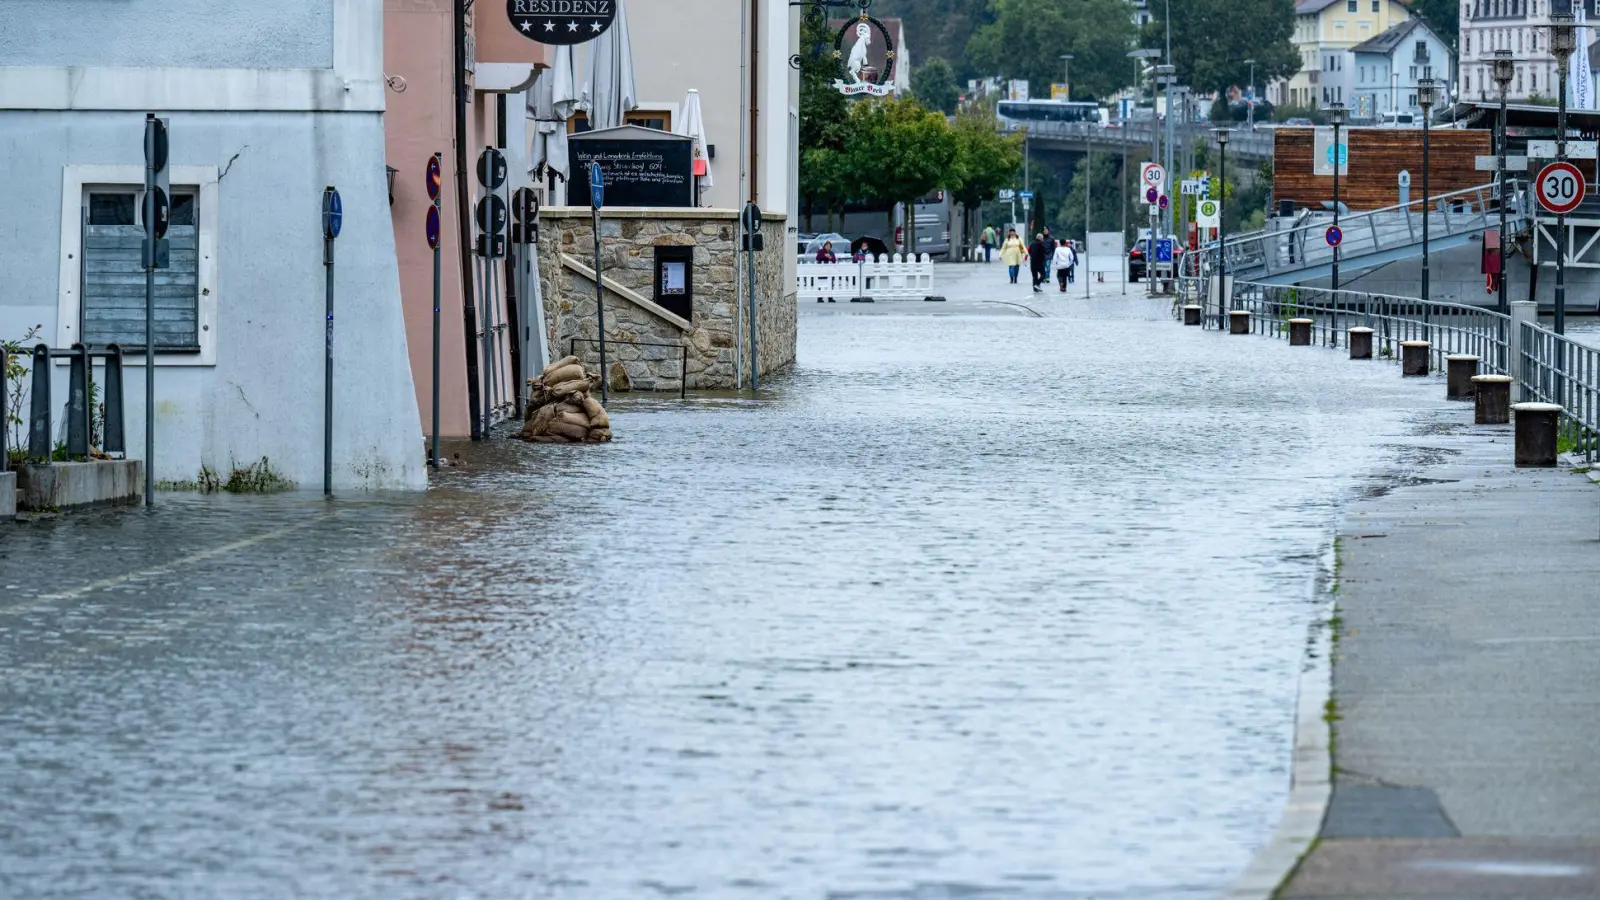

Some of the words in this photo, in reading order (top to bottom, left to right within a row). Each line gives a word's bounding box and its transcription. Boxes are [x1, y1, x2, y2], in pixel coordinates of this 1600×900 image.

[514, 0, 609, 13] RESIDENZ
[1147, 170, 1160, 181] 30
[1547, 176, 1574, 199] 30
[1205, 204, 1213, 213] H
